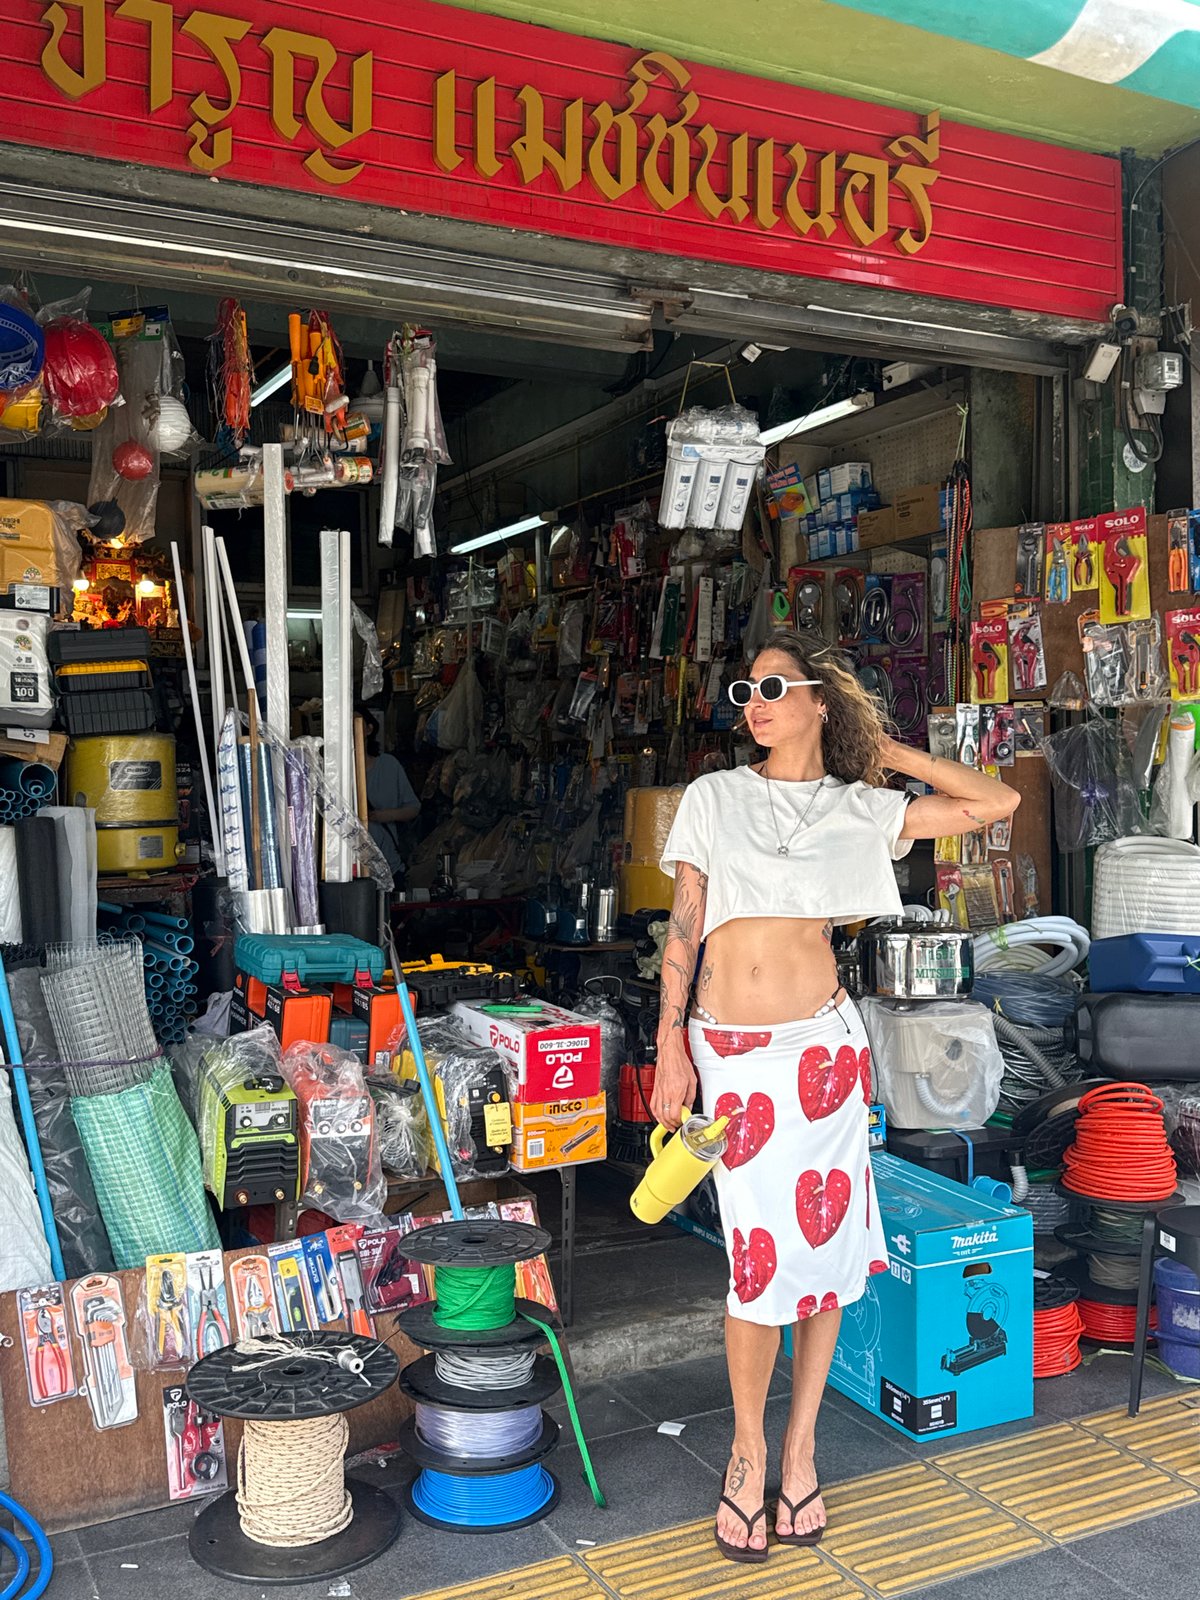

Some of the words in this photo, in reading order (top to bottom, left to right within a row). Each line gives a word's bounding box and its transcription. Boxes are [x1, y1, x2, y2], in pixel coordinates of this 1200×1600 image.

[433, 51, 941, 256] แมชชินเนอรี่
[1074, 523, 1095, 531] SOLO
[1104, 515, 1140, 529] SOLO
[975, 625, 1002, 634] SOLO
[14, 687, 35, 697] 100
[498, 1033, 520, 1054] POLO
[545, 1051, 582, 1065] POLO
[367, 1236, 386, 1245] POLO
[166, 1400, 187, 1409] POLO
